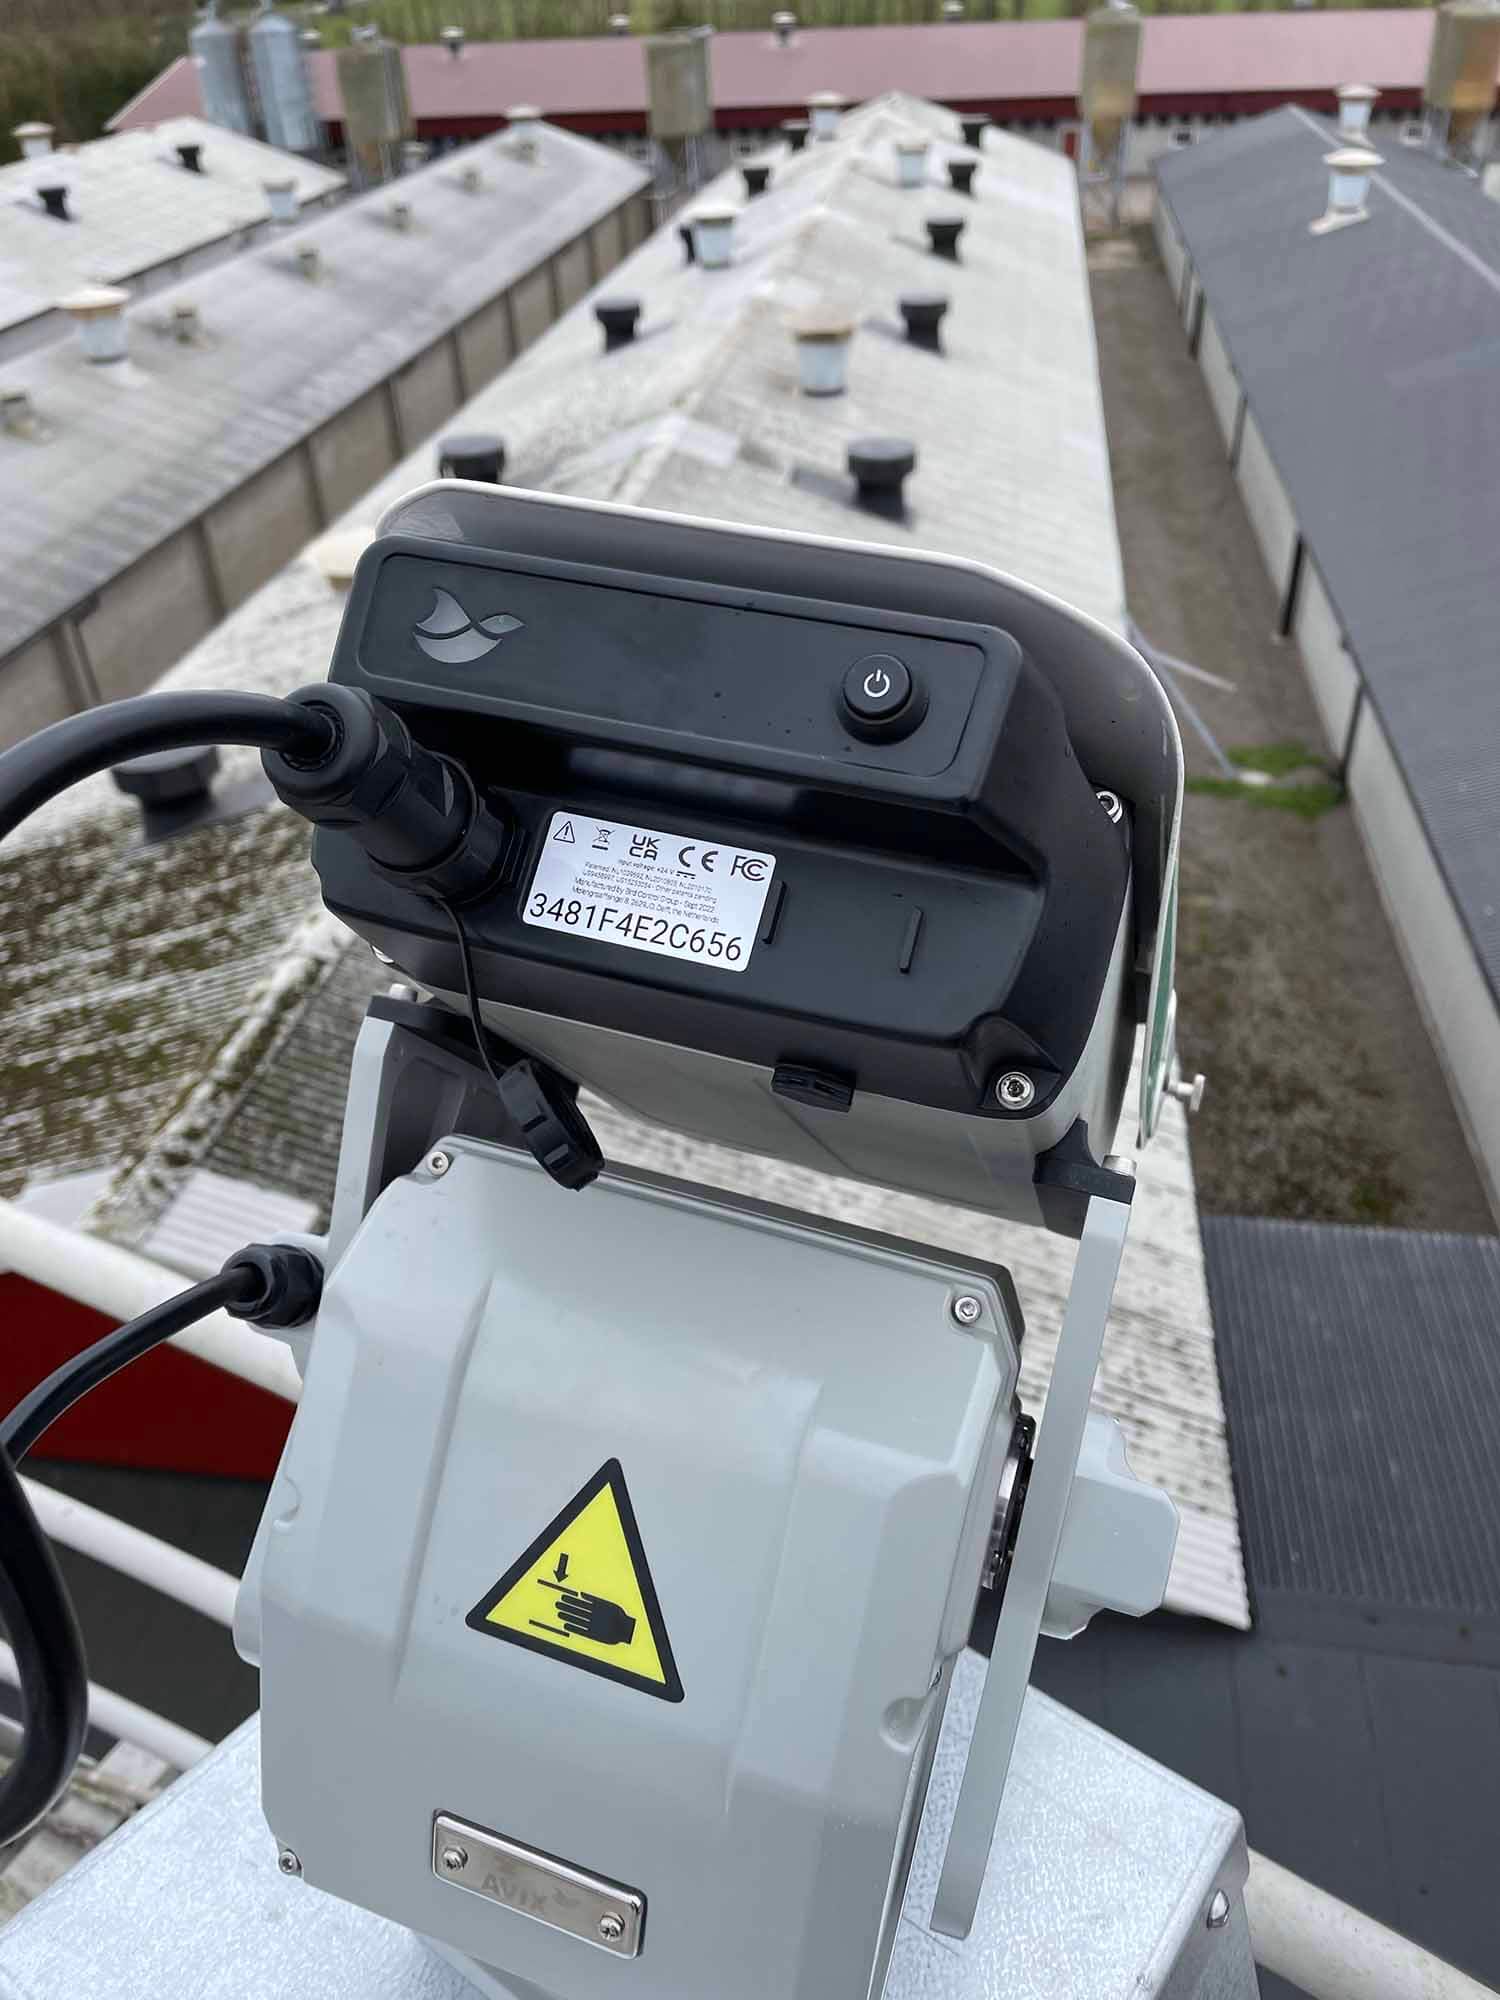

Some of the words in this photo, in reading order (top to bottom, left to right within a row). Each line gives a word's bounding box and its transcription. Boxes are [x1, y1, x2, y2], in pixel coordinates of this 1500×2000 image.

[633, 834, 661, 850] UK
[629, 847, 658, 862] CA
[678, 846, 719, 873] CE
[529, 892, 742, 962] 3481F4E2C656
